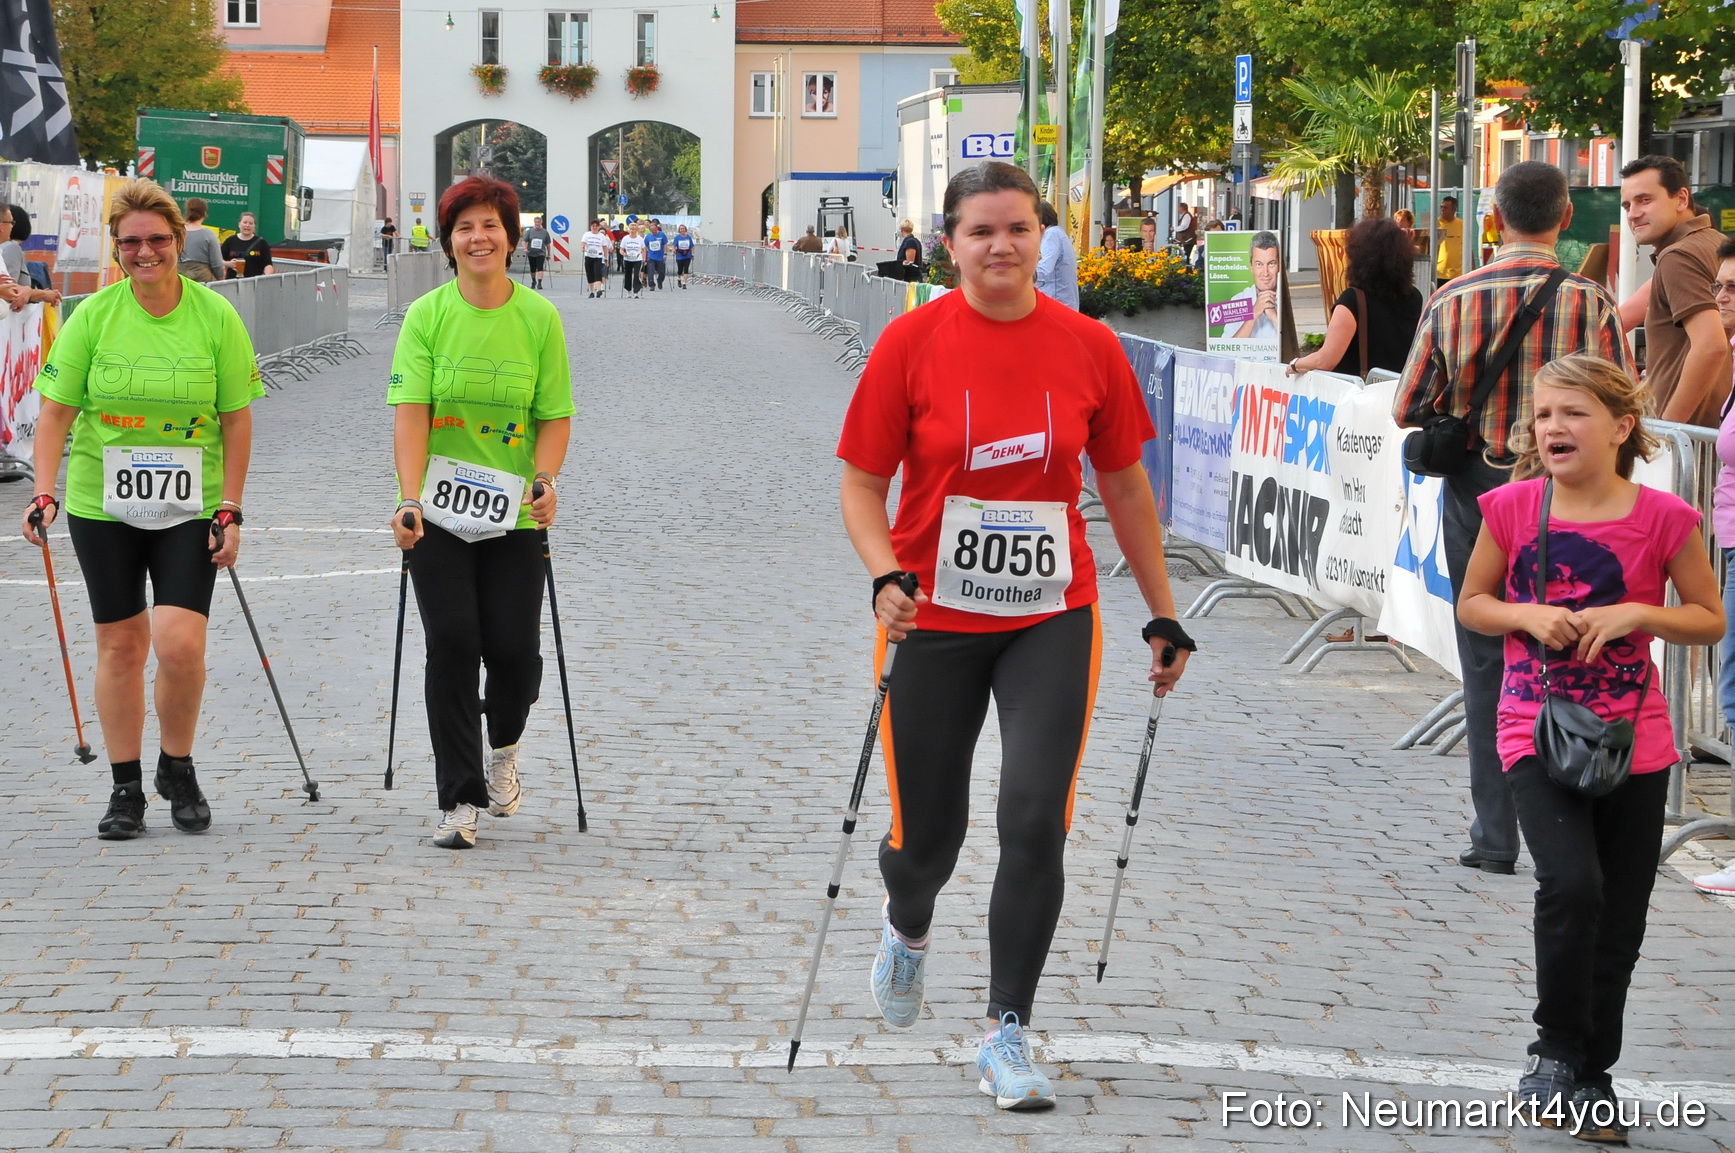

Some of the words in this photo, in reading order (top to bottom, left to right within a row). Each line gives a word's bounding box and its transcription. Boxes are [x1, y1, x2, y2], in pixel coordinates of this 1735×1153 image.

[1239, 62, 1248, 96] P
[1040, 127, 1055, 135] Kinder-
[182, 170, 239, 183] Neumarkter
[171, 178, 248, 196] Lammsbräu
[1221, 301, 1248, 310] WERNER
[1209, 344, 1241, 352] WERNER
[1242, 344, 1278, 352] THUMANN
[99, 411, 146, 428] MERZ
[433, 416, 465, 429] ERZ
[1336, 426, 1385, 461] Kastengas
[131, 453, 173, 462] BOCK
[991, 444, 1025, 460] DEHN
[455, 467, 496, 483] BOCK
[116, 469, 192, 500] 8070
[432, 480, 510, 523] 8099
[981, 510, 1034, 523] BOCK
[954, 529, 1056, 577] 8056
[942, 559, 948, 567] N
[1325, 555, 1348, 583] 92318
[961, 579, 1042, 603] Dorothea
[869, 697, 883, 730] NORDIC
